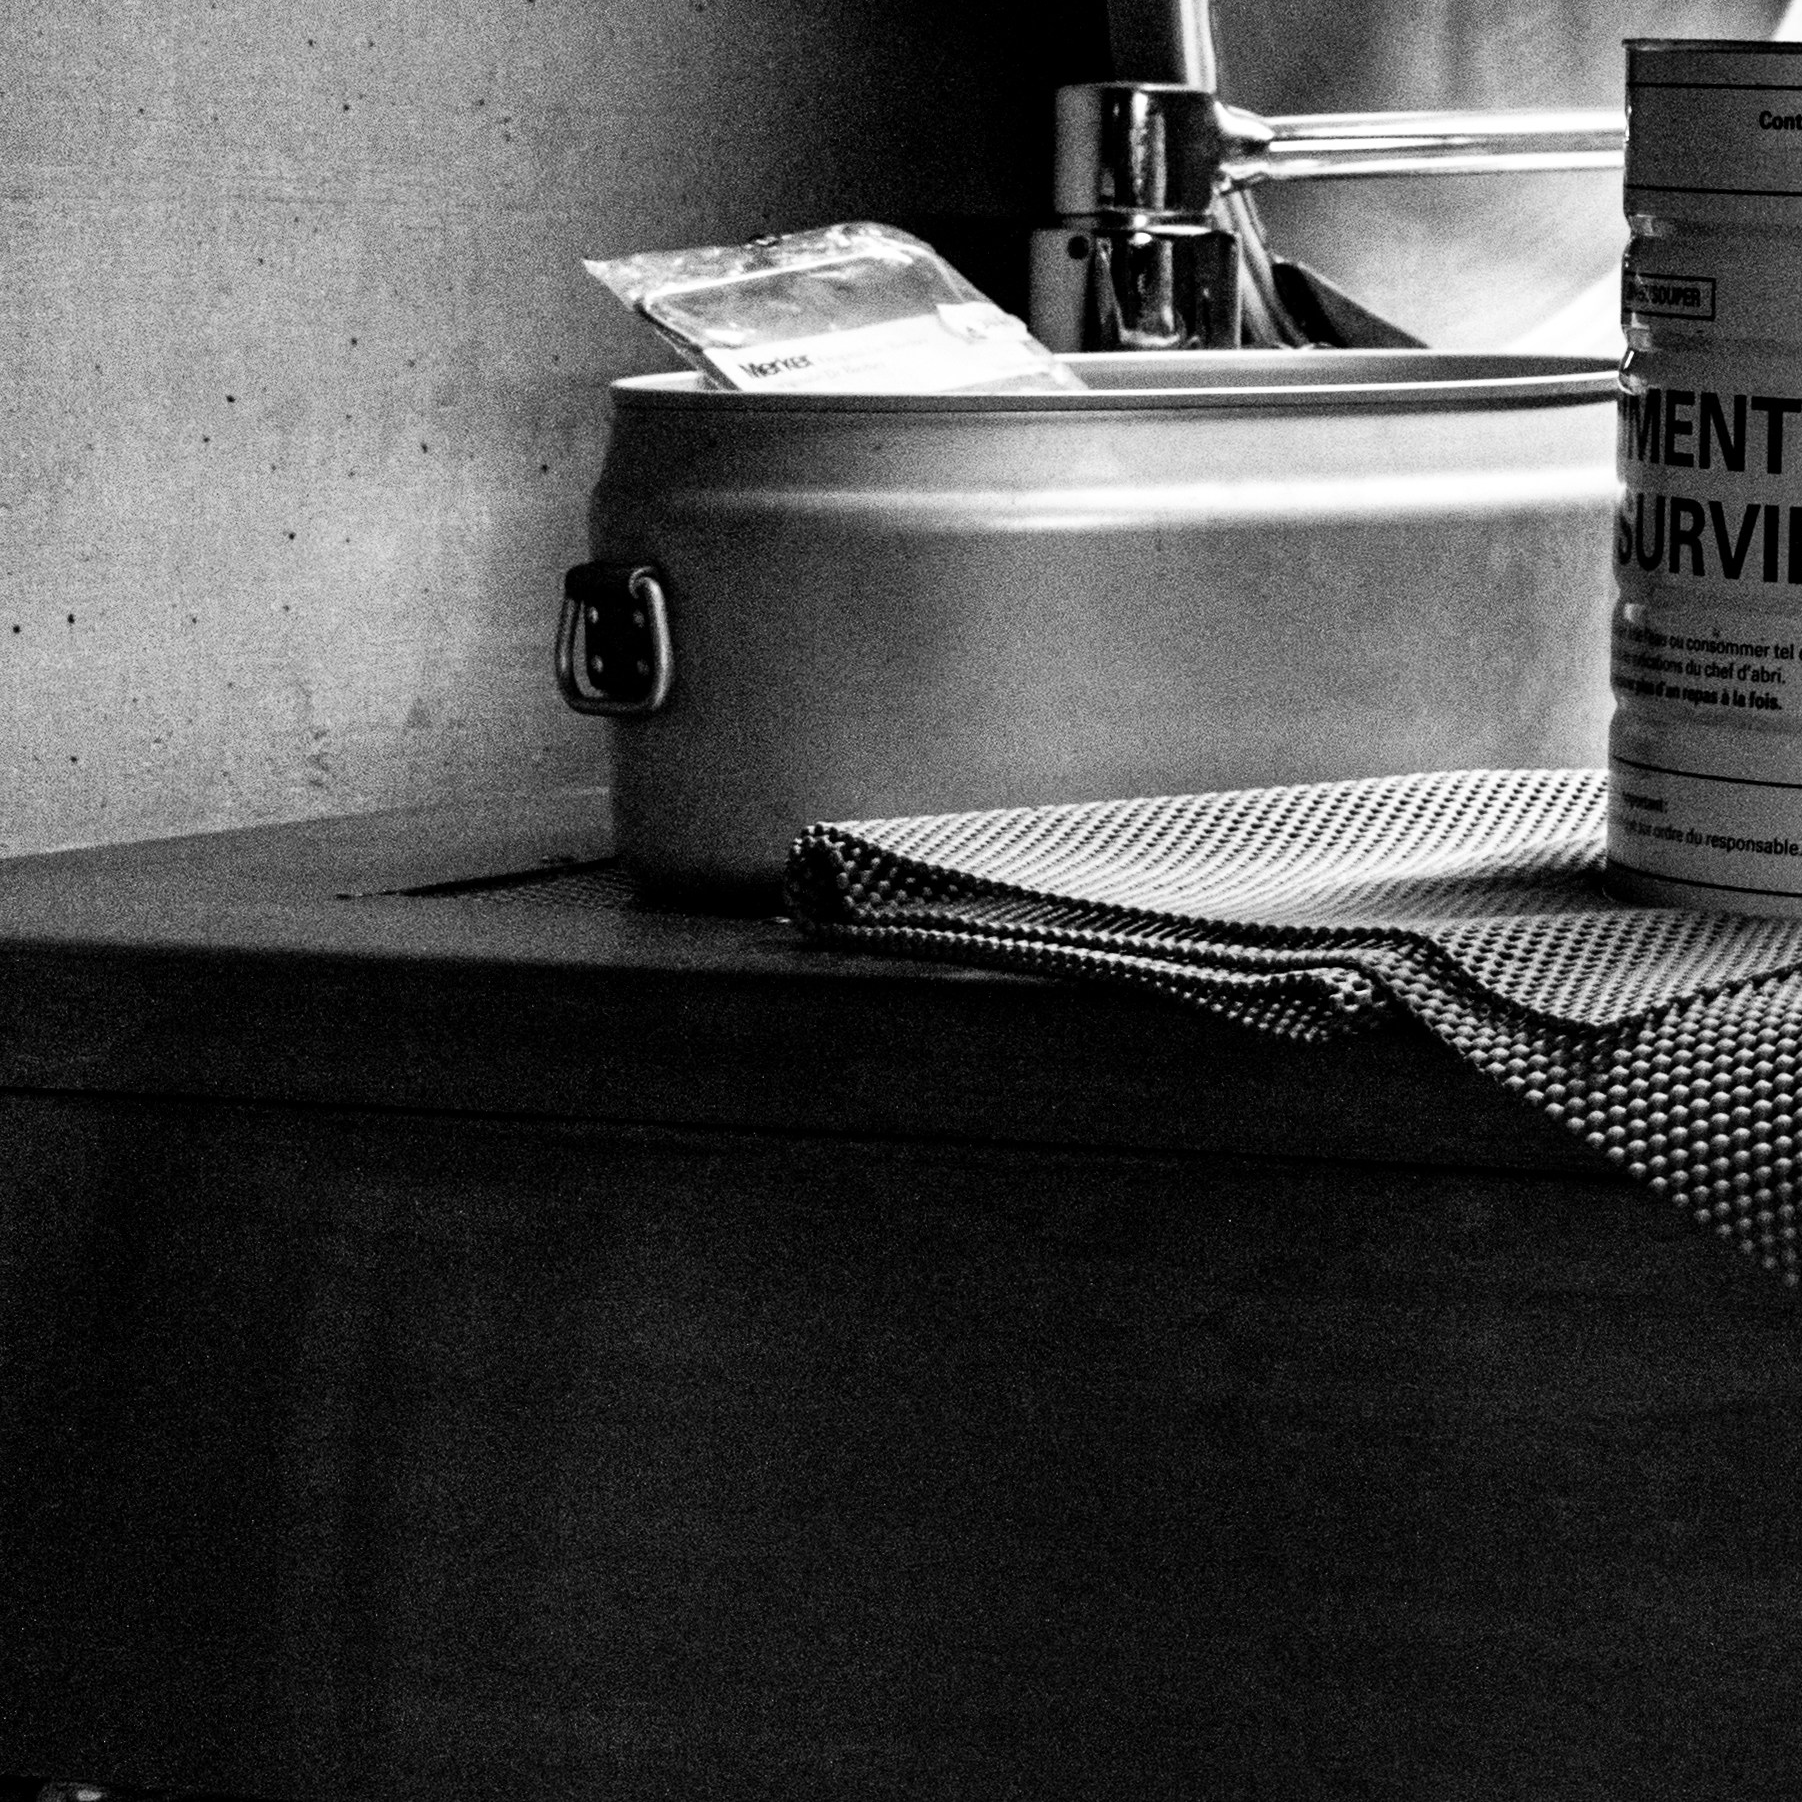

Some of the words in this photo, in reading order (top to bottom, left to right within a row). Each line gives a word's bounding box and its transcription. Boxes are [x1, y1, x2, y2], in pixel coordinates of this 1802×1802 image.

[1686, 638, 1770, 658] consommer
[1774, 643, 1794, 660] tel
[1686, 660, 1701, 676] du
[1704, 662, 1734, 680] chef
[1737, 665, 1786, 685] d'abri.
[1683, 687, 1718, 706] repas
[1721, 689, 1730, 706] à
[1733, 690, 1746, 707] la
[1749, 691, 1783, 710] fois.
[1686, 827, 1702, 845] du
[1706, 833, 1802, 857] responsable.
